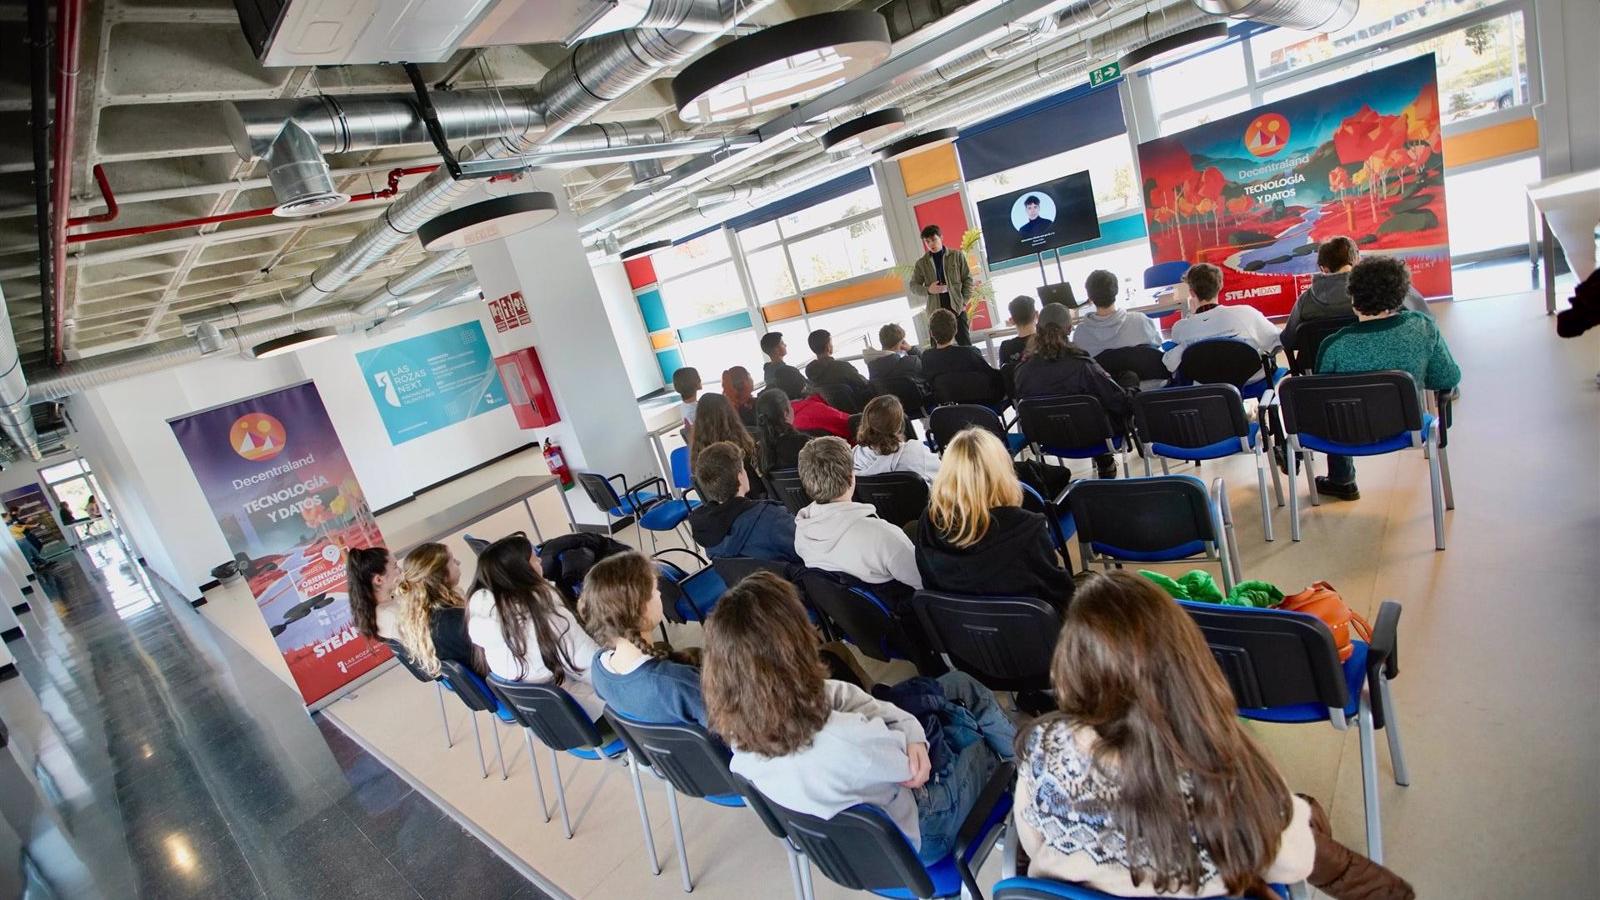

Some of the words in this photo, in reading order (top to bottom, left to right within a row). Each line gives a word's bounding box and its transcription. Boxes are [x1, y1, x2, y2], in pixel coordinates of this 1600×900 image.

[1238, 153, 1310, 180] Decentraland
[1244, 173, 1306, 195] TECNOLOGÍA
[1256, 195, 1264, 204] Y
[1264, 188, 1296, 202] DATOS
[390, 364, 410, 378] LAS
[393, 369, 427, 385] ROZAS
[397, 379, 423, 393] NEXT
[232, 453, 315, 490] Decentraland
[243, 474, 329, 514] TECNOLOGÍA
[267, 511, 278, 523] Y
[278, 494, 322, 519] DATOS
